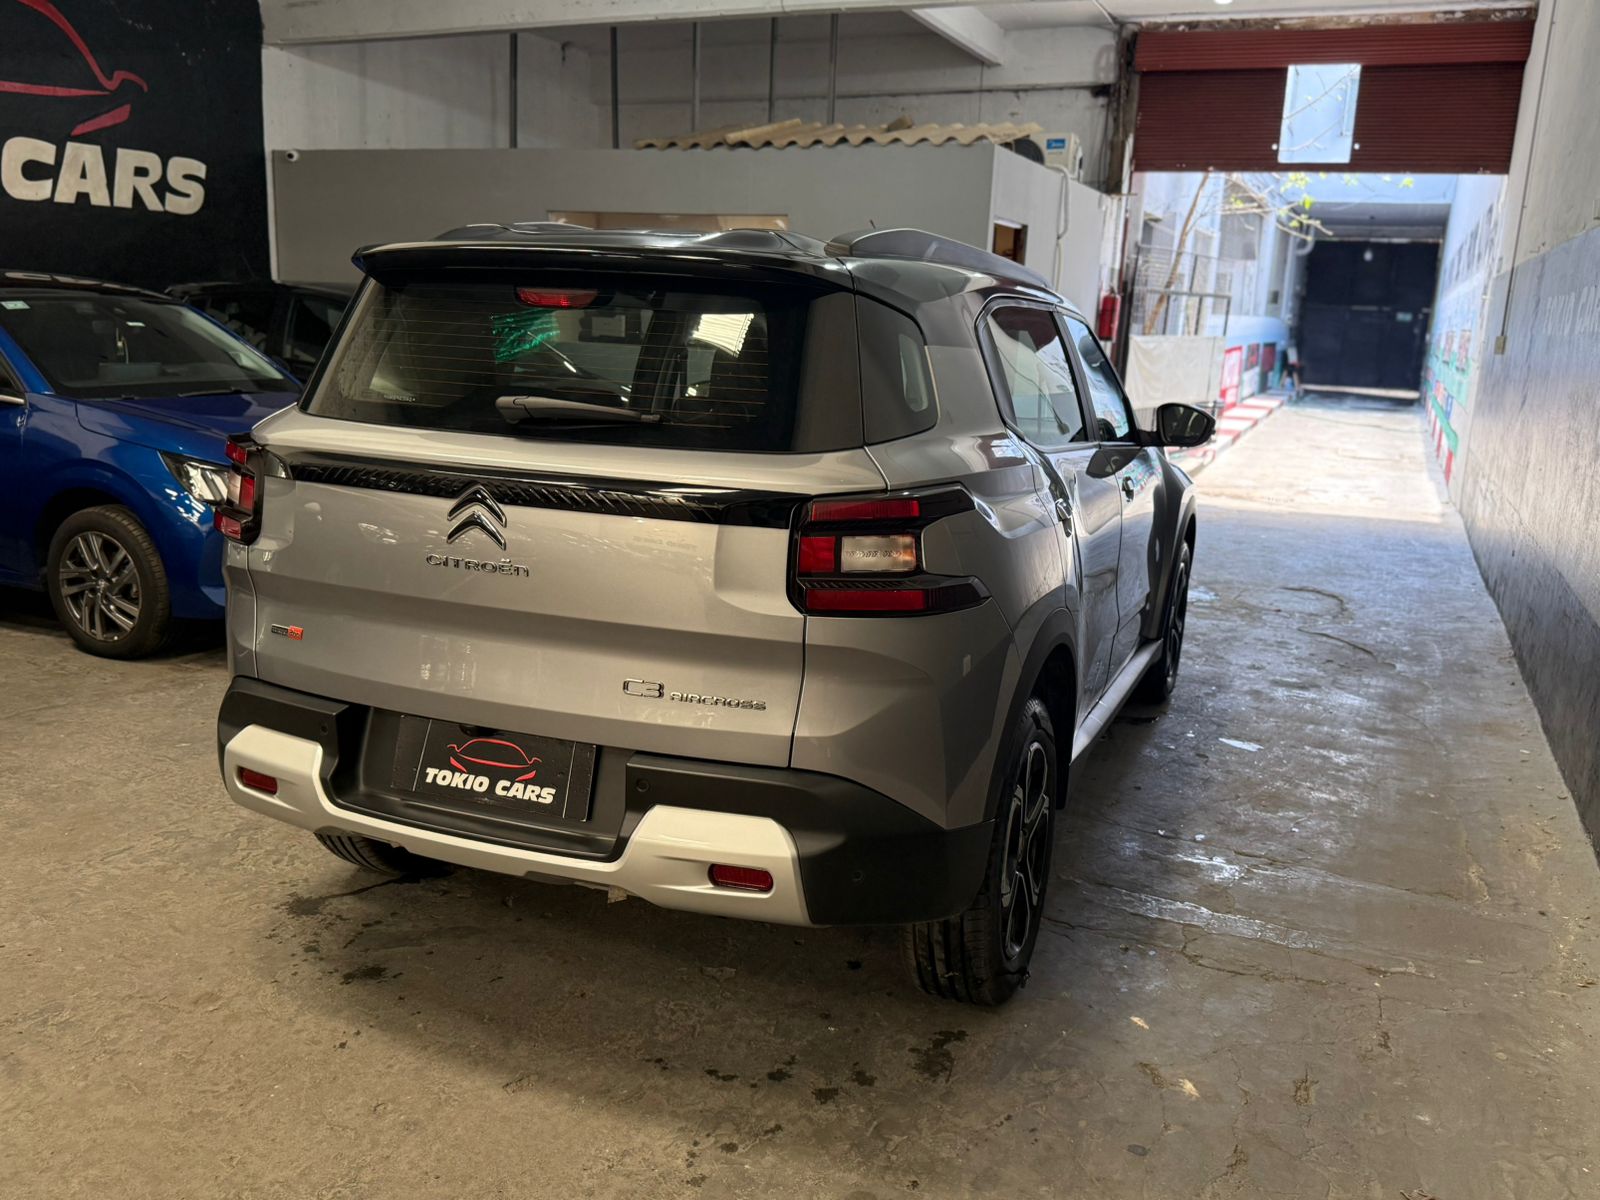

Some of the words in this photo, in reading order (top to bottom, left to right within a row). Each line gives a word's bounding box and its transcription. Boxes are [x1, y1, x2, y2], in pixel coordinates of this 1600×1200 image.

[1, 136, 207, 215] CARS
[622, 678, 665, 699] C3
[670, 691, 767, 712] AIRCROSS
[425, 767, 490, 793] TOKIO
[494, 779, 556, 805] CARS
